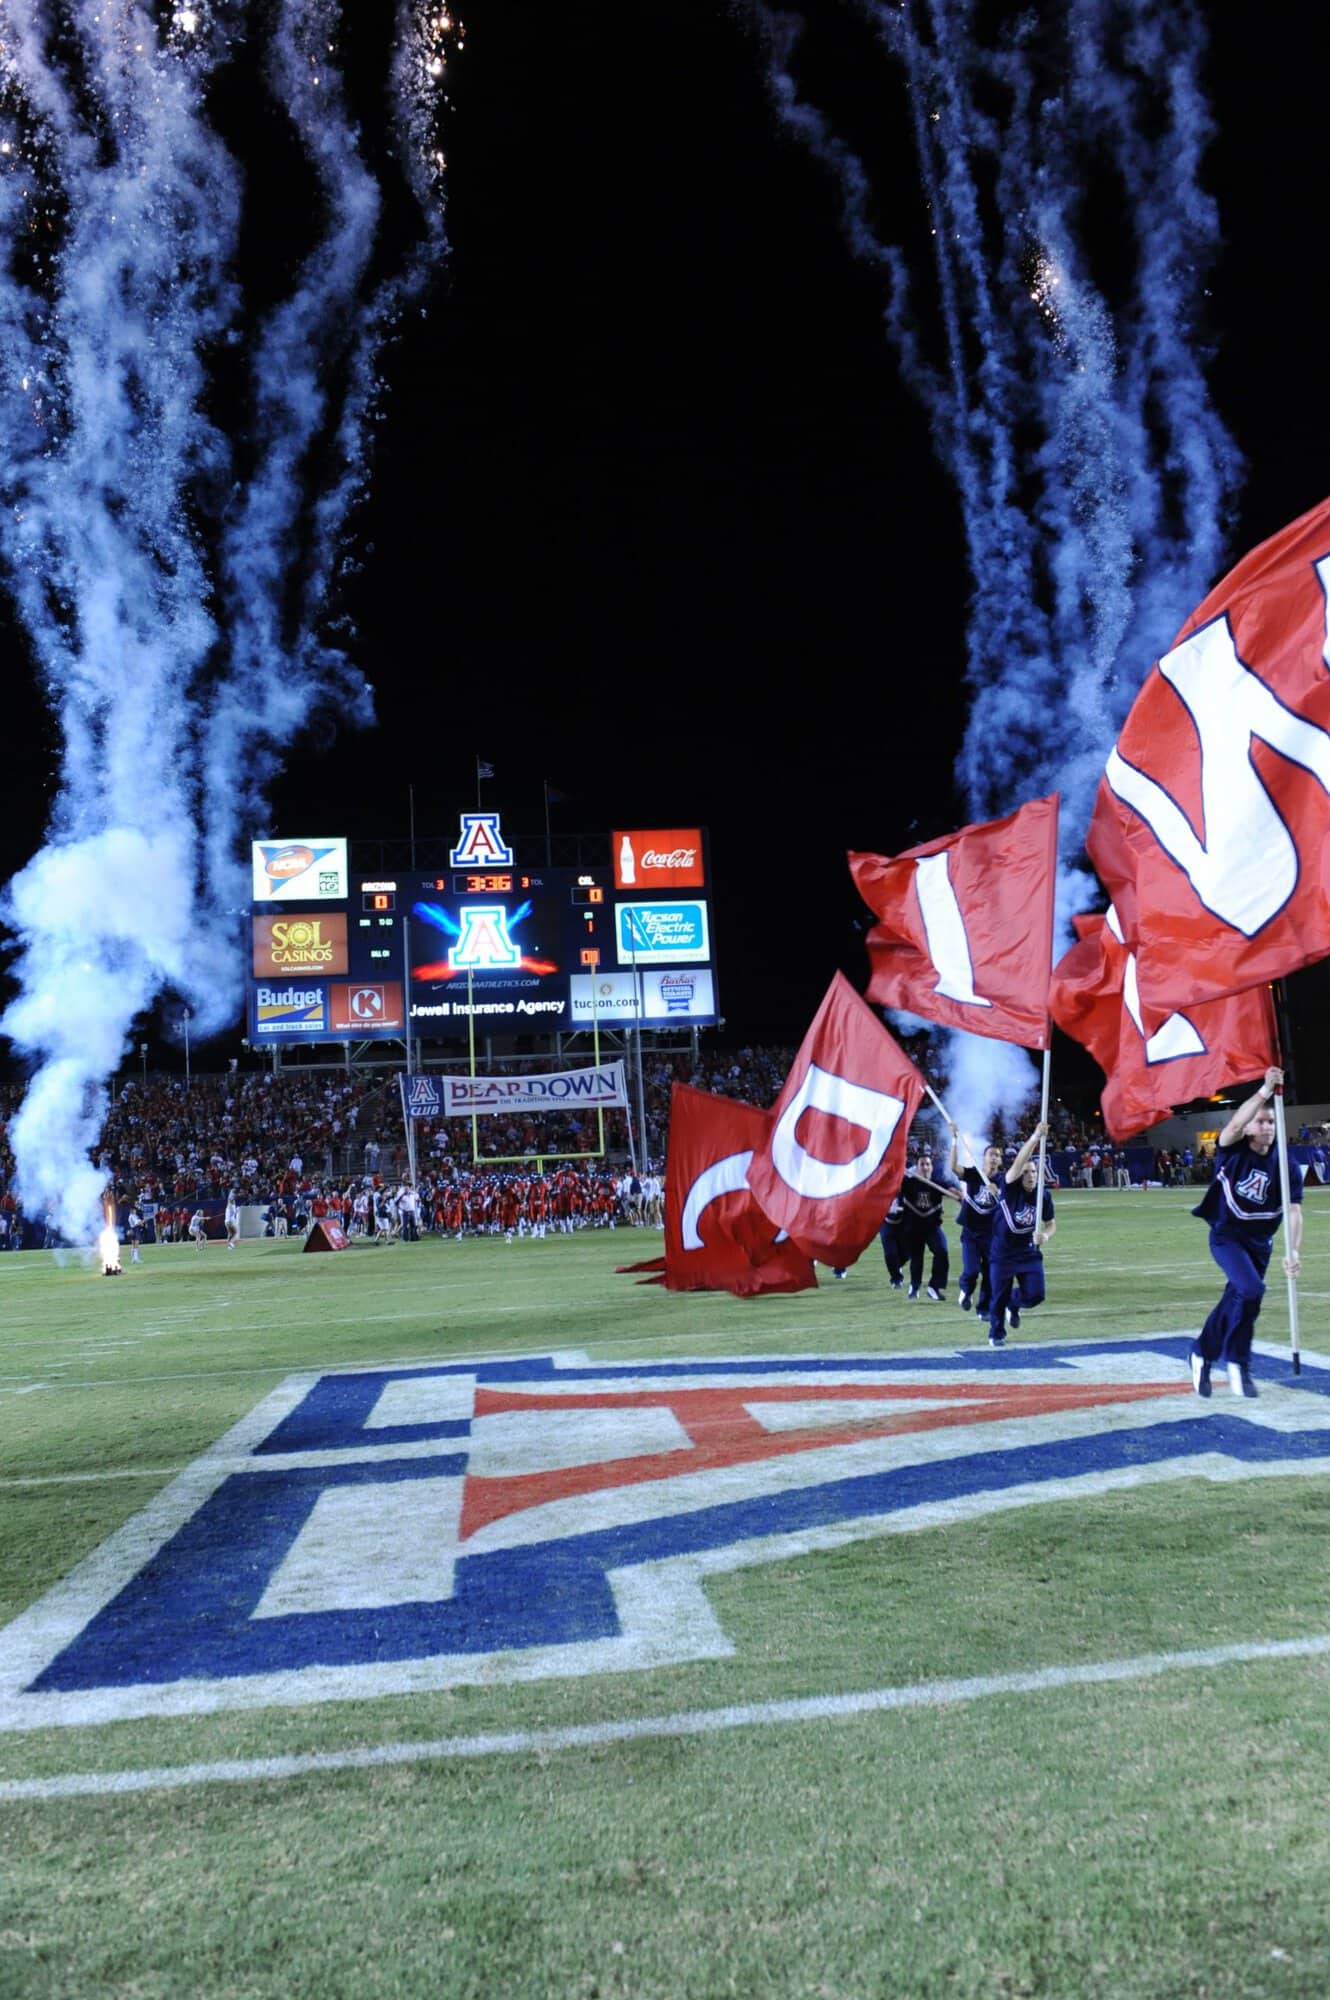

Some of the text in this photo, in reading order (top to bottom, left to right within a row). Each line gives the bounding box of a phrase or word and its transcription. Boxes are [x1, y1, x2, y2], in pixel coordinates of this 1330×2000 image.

[450, 813, 513, 868] A
[641, 848, 696, 869] Coca-Cola
[466, 875, 512, 892] 3:36
[520, 876, 530, 888] 3
[641, 911, 683, 923] Tucson
[271, 920, 332, 950] SOL
[646, 921, 696, 933] Electric
[652, 933, 695, 945] Power
[271, 948, 333, 963] CASINOS
[446, 978, 540, 990] ARIZOAATHLETICS.COM
[257, 987, 323, 1009] Budget
[409, 999, 565, 1017] Jewell Insurance Agency
[410, 1105, 439, 1116] CLUB
[1234, 1168, 1270, 1204] A
